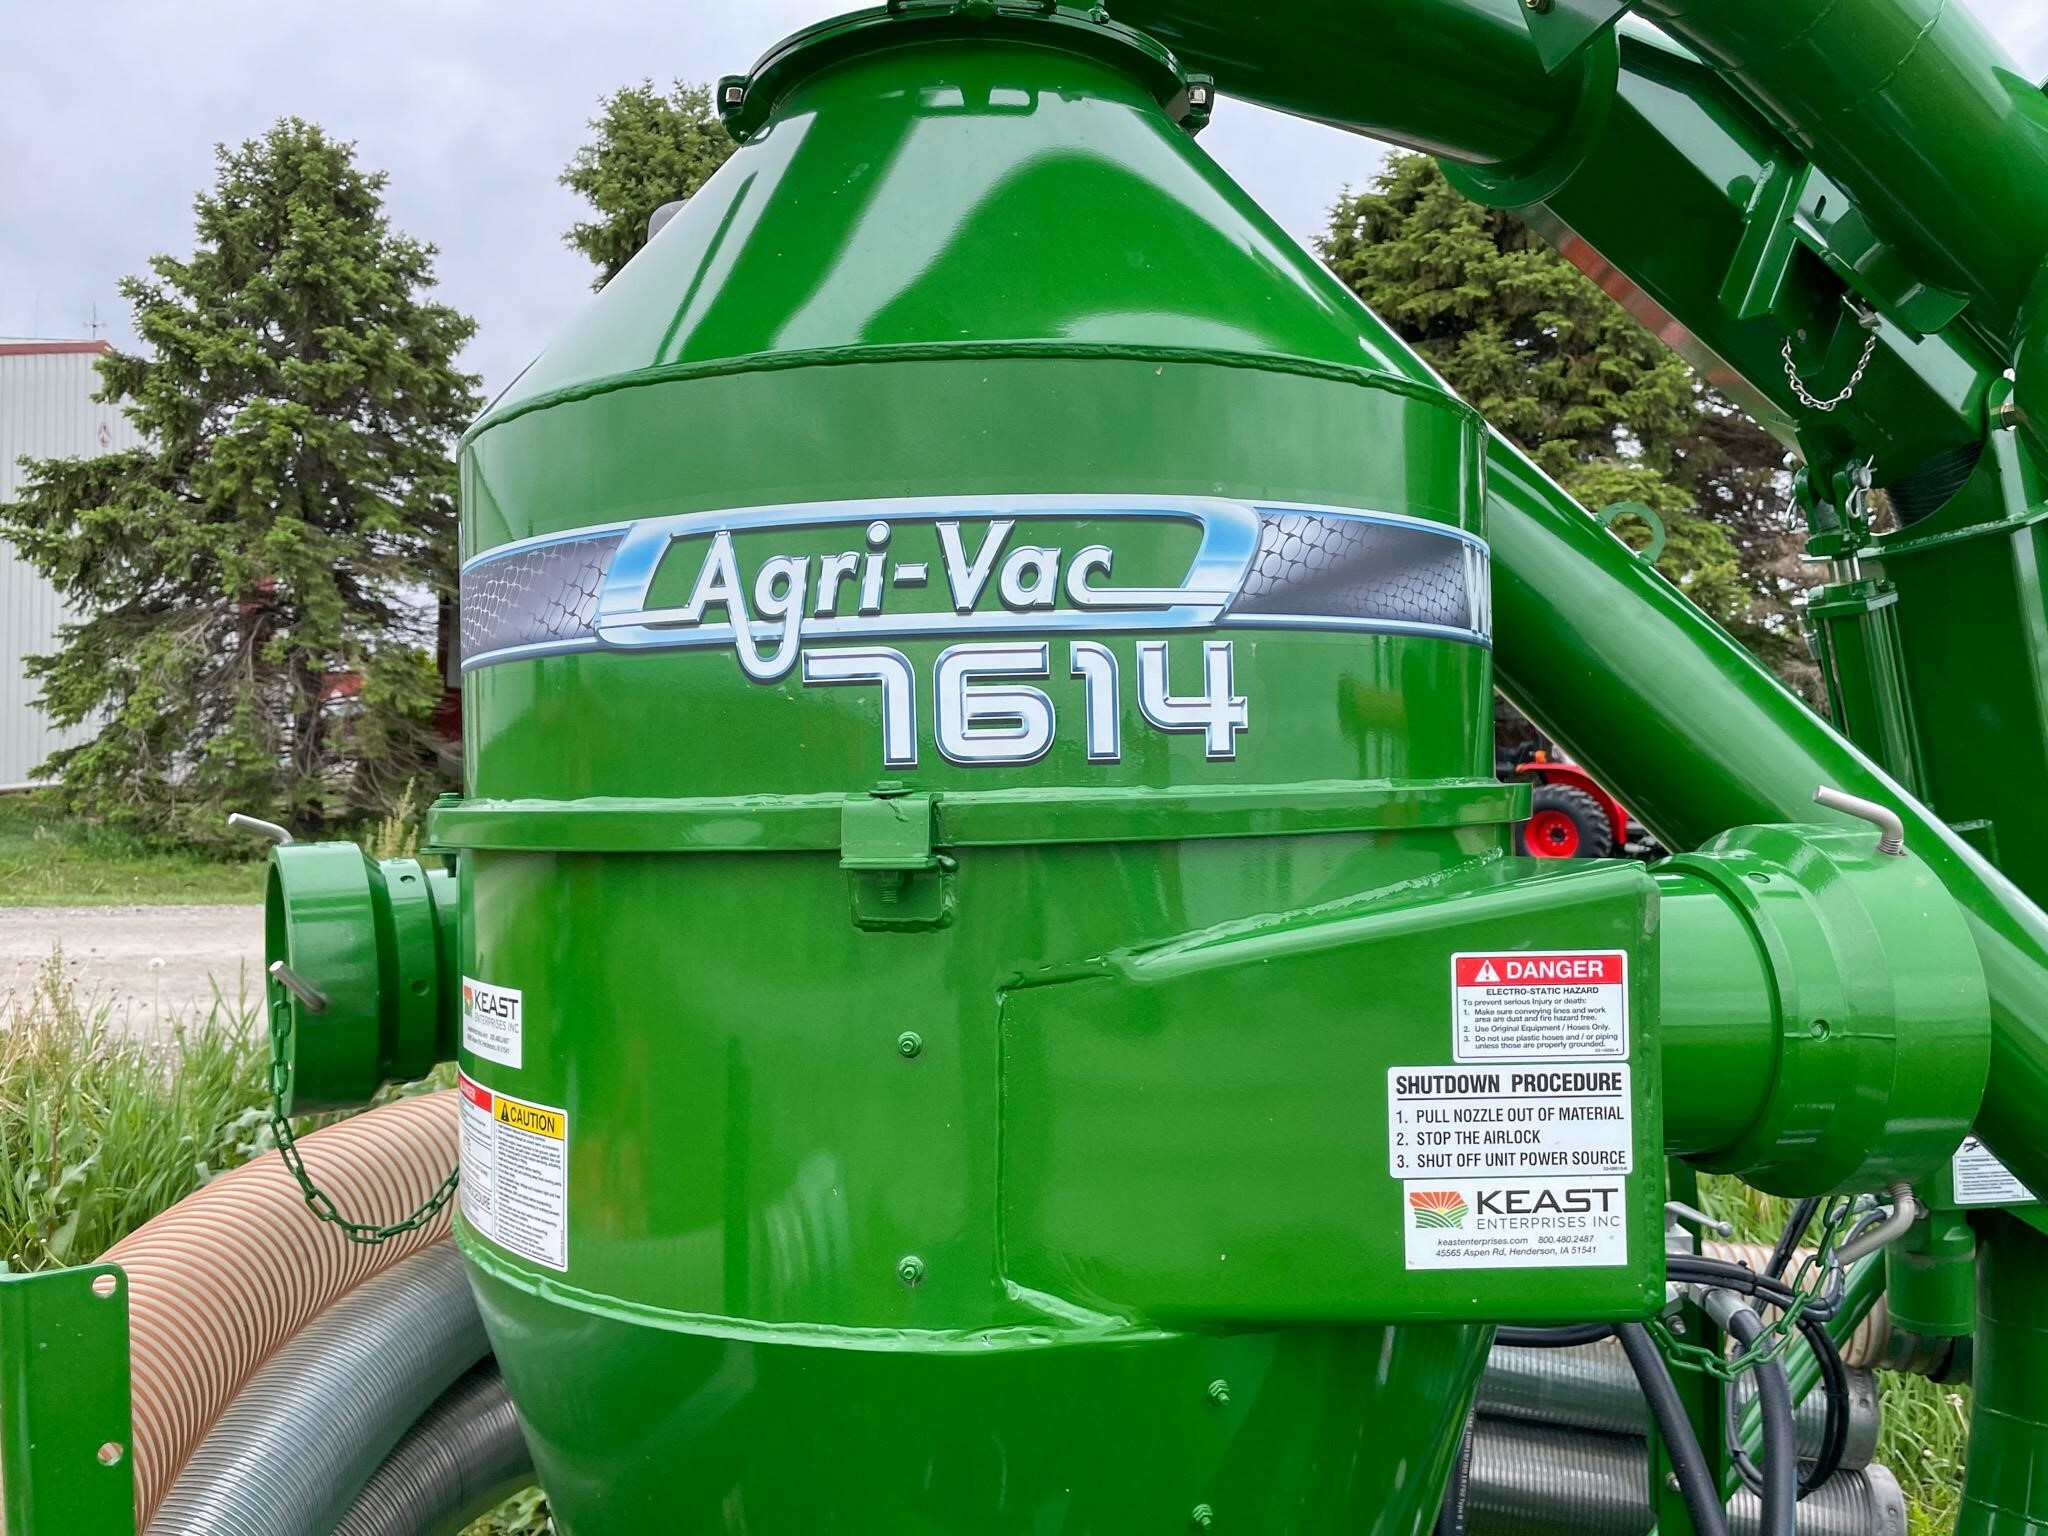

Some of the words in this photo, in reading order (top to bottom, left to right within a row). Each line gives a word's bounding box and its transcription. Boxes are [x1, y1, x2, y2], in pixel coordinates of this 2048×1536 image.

[686, 518, 1114, 681] Agri-Vac
[802, 640, 1249, 766] 7614
[1506, 960, 1603, 979] DANGER
[474, 989, 518, 1020] KEAST
[1474, 999, 1502, 1007] prevent
[1514, 1008, 1551, 1017] conveying
[508, 1022, 519, 1033] INC
[1522, 1024, 1560, 1032] Equipment
[1592, 1024, 1610, 1032] Only.
[1516, 1034, 1540, 1042] plastic
[1596, 1033, 1618, 1041] piping
[1537, 1041, 1567, 1049] properly
[1396, 1074, 1500, 1095] SHUTDOWN
[1511, 1072, 1622, 1093] PROCEDURE
[509, 1106, 555, 1133] CAUTION
[1396, 1111, 1408, 1124] 1.
[1417, 1110, 1449, 1123] PULL
[1454, 1109, 1504, 1123] NOZZLE
[1508, 1108, 1534, 1122] OUT
[1538, 1108, 1555, 1121] OF
[1559, 1106, 1624, 1121] MATERIAL
[1396, 1132, 1408, 1146] 2.
[1417, 1132, 1451, 1146] STOP
[1455, 1131, 1480, 1145] THE
[1484, 1130, 1540, 1144] AIRLOCK
[1397, 1155, 1409, 1168] 3.
[1417, 1154, 1453, 1168] SHUT
[1457, 1153, 1481, 1167] OFF
[1486, 1153, 1516, 1166] UNIT
[1520, 1152, 1568, 1166] POWER
[1572, 1151, 1625, 1165] SOURCE
[1477, 1188, 1619, 1214] KEAST
[1477, 1217, 1586, 1230] ENTERPRISES
[1593, 1216, 1620, 1227] INC
[1438, 1237, 1528, 1247] keastenterprises.com
[1538, 1235, 1594, 1243] 800.480.2487
[1436, 1249, 1461, 1257] 45565
[1463, 1249, 1490, 1258] Aspen
[1492, 1248, 1507, 1256] Rd,
[1509, 1247, 1558, 1256] Henderson,
[1572, 1246, 1596, 1254] 51541
